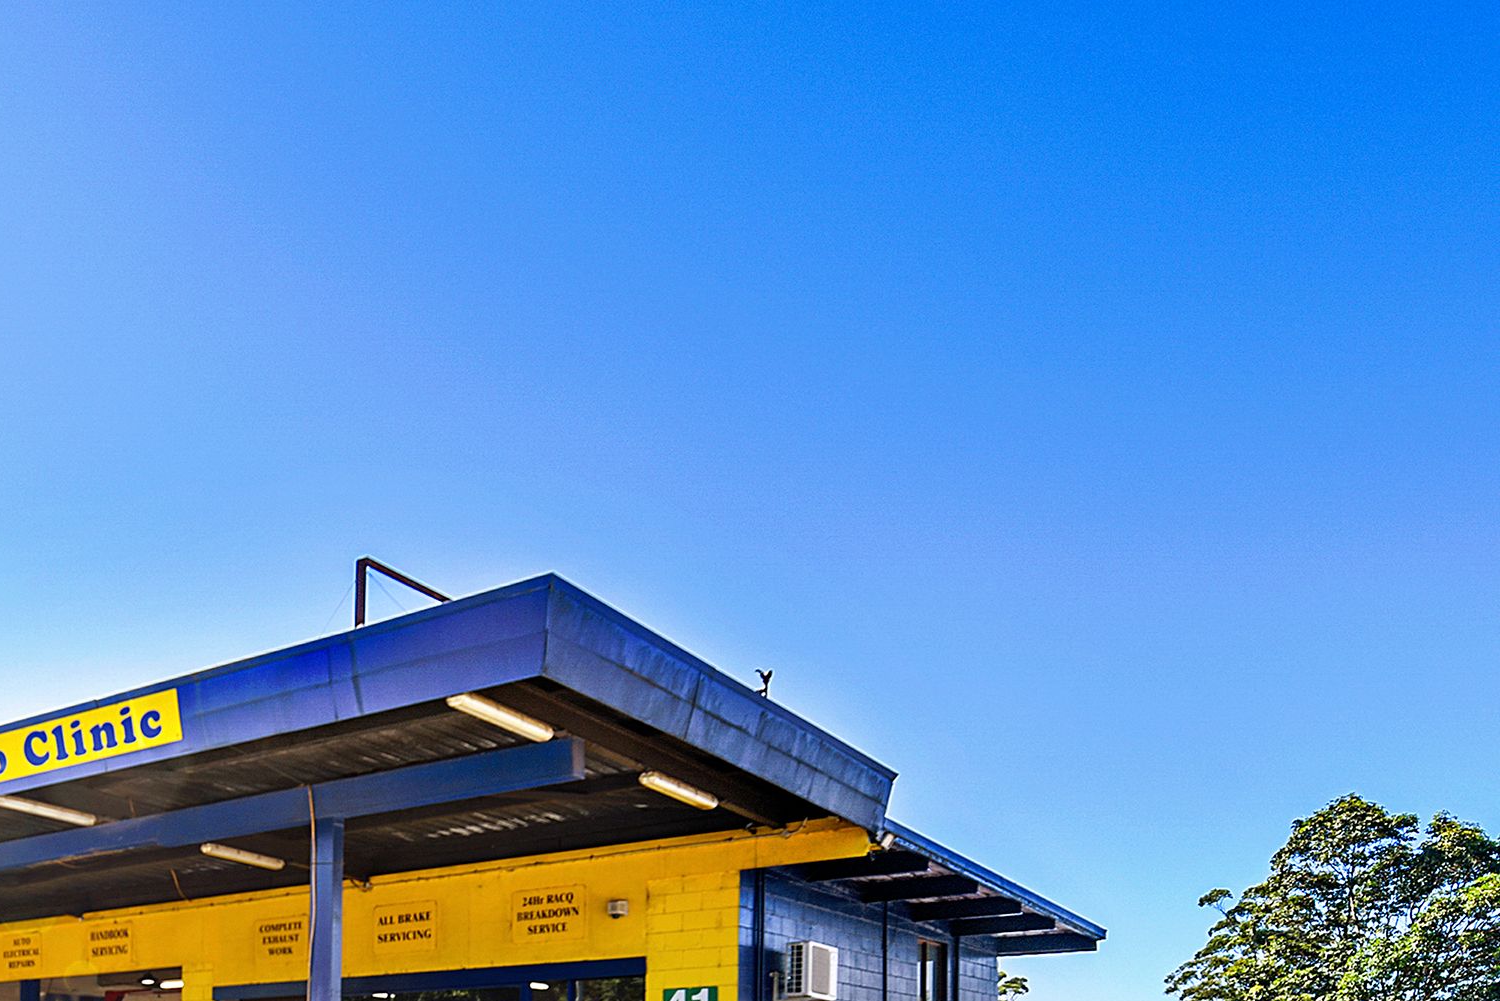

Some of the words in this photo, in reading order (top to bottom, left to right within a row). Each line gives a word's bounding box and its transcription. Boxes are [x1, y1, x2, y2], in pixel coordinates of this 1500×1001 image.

[23, 704, 163, 766] Clinic
[521, 895, 545, 908] 24Hr
[546, 891, 575, 905] RACQ
[377, 914, 396, 926] ALL
[397, 911, 432, 924] BRAKE
[516, 906, 580, 922] BREAKDOWN
[259, 921, 302, 934] COMPLETE
[527, 922, 568, 935] SERVICE
[90, 928, 129, 942] HANDBOOK
[262, 933, 300, 945] EXHAUST
[377, 928, 432, 944] SERVICING
[91, 944, 129, 957] SERVICING
[268, 946, 294, 956] WORK
[8, 960, 36, 969] REPAIRS
